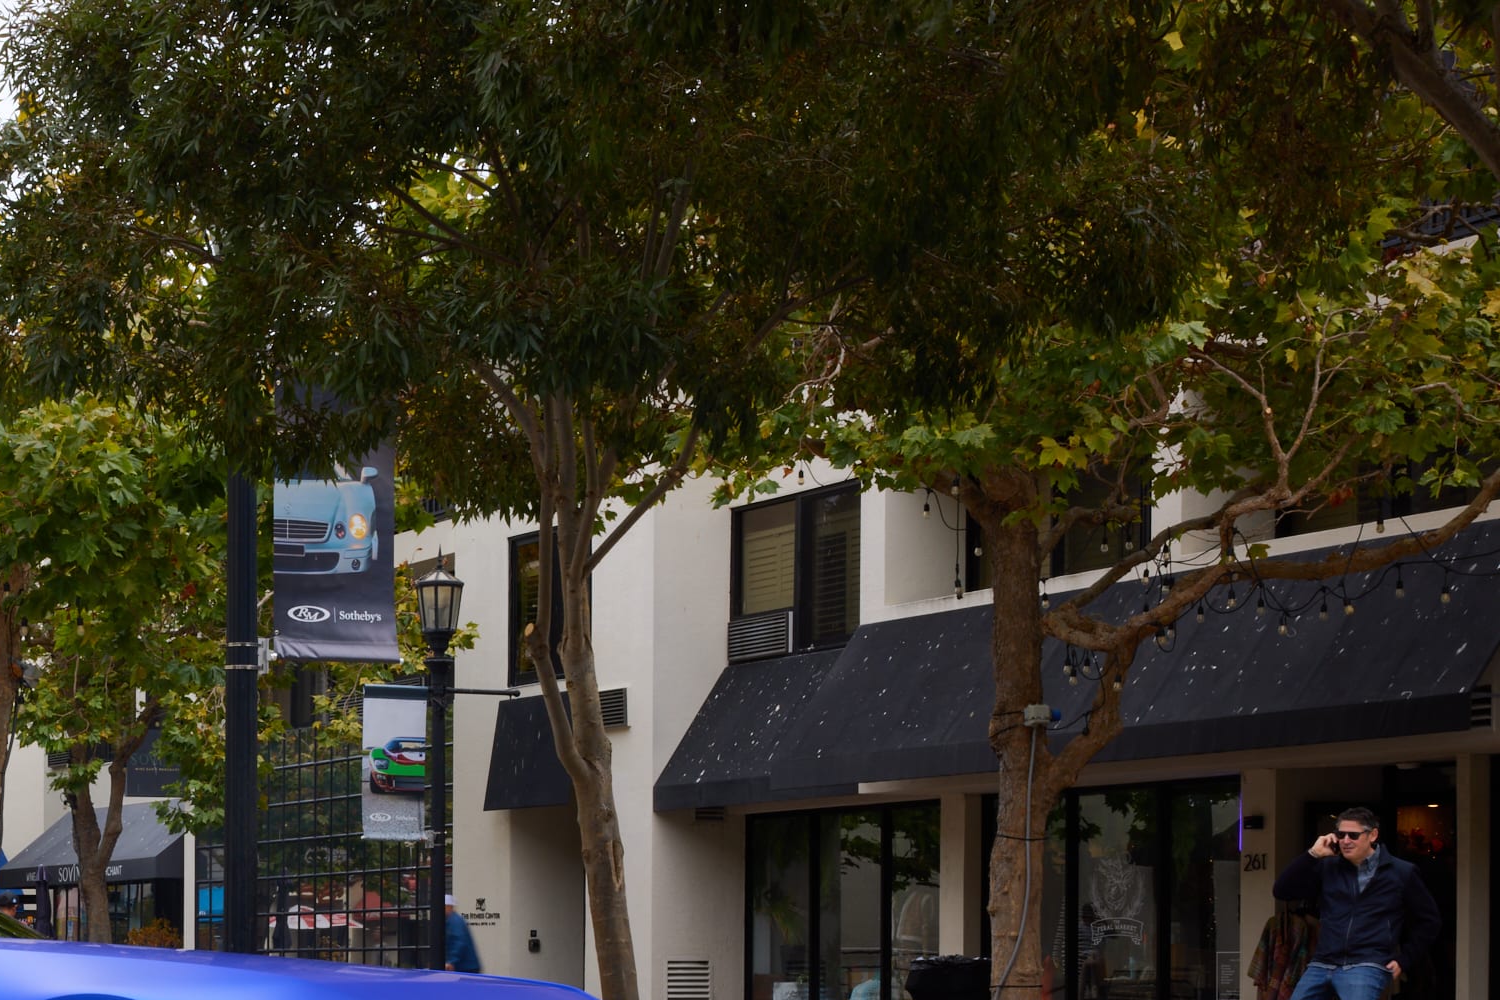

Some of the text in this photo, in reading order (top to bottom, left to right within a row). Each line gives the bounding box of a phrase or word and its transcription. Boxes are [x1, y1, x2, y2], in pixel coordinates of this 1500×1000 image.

[339, 610, 382, 623] Sotheby's
[1243, 853, 1268, 872] 261
[105, 865, 123, 877] CHANT
